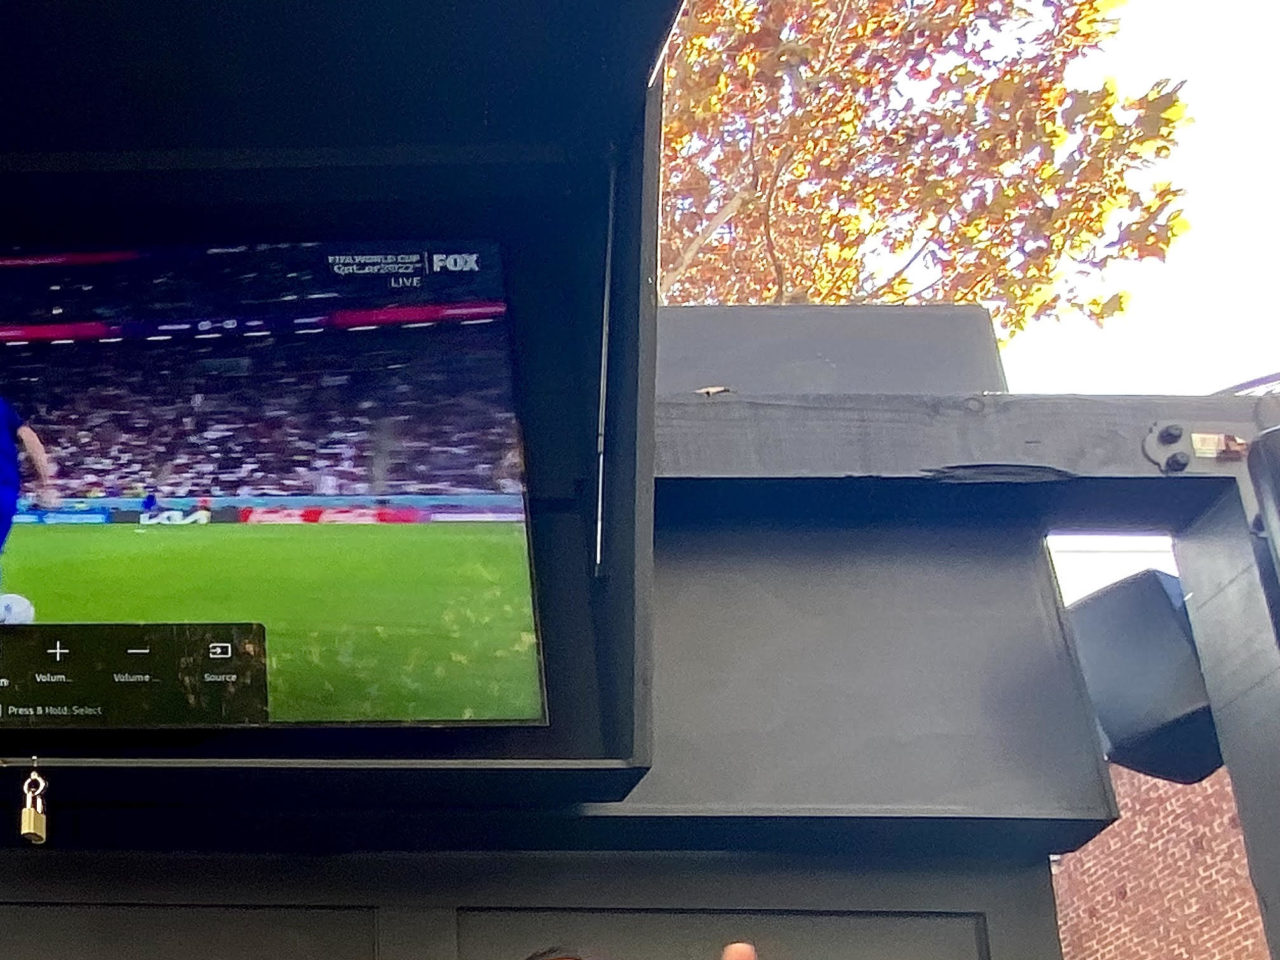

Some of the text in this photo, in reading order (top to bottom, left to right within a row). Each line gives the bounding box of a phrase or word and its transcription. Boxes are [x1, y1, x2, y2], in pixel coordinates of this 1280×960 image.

[433, 253, 479, 272] FOX
[391, 277, 421, 288] LIVE
[204, 673, 238, 682] Source
[8, 706, 34, 715] Press
[73, 706, 103, 715] Select
